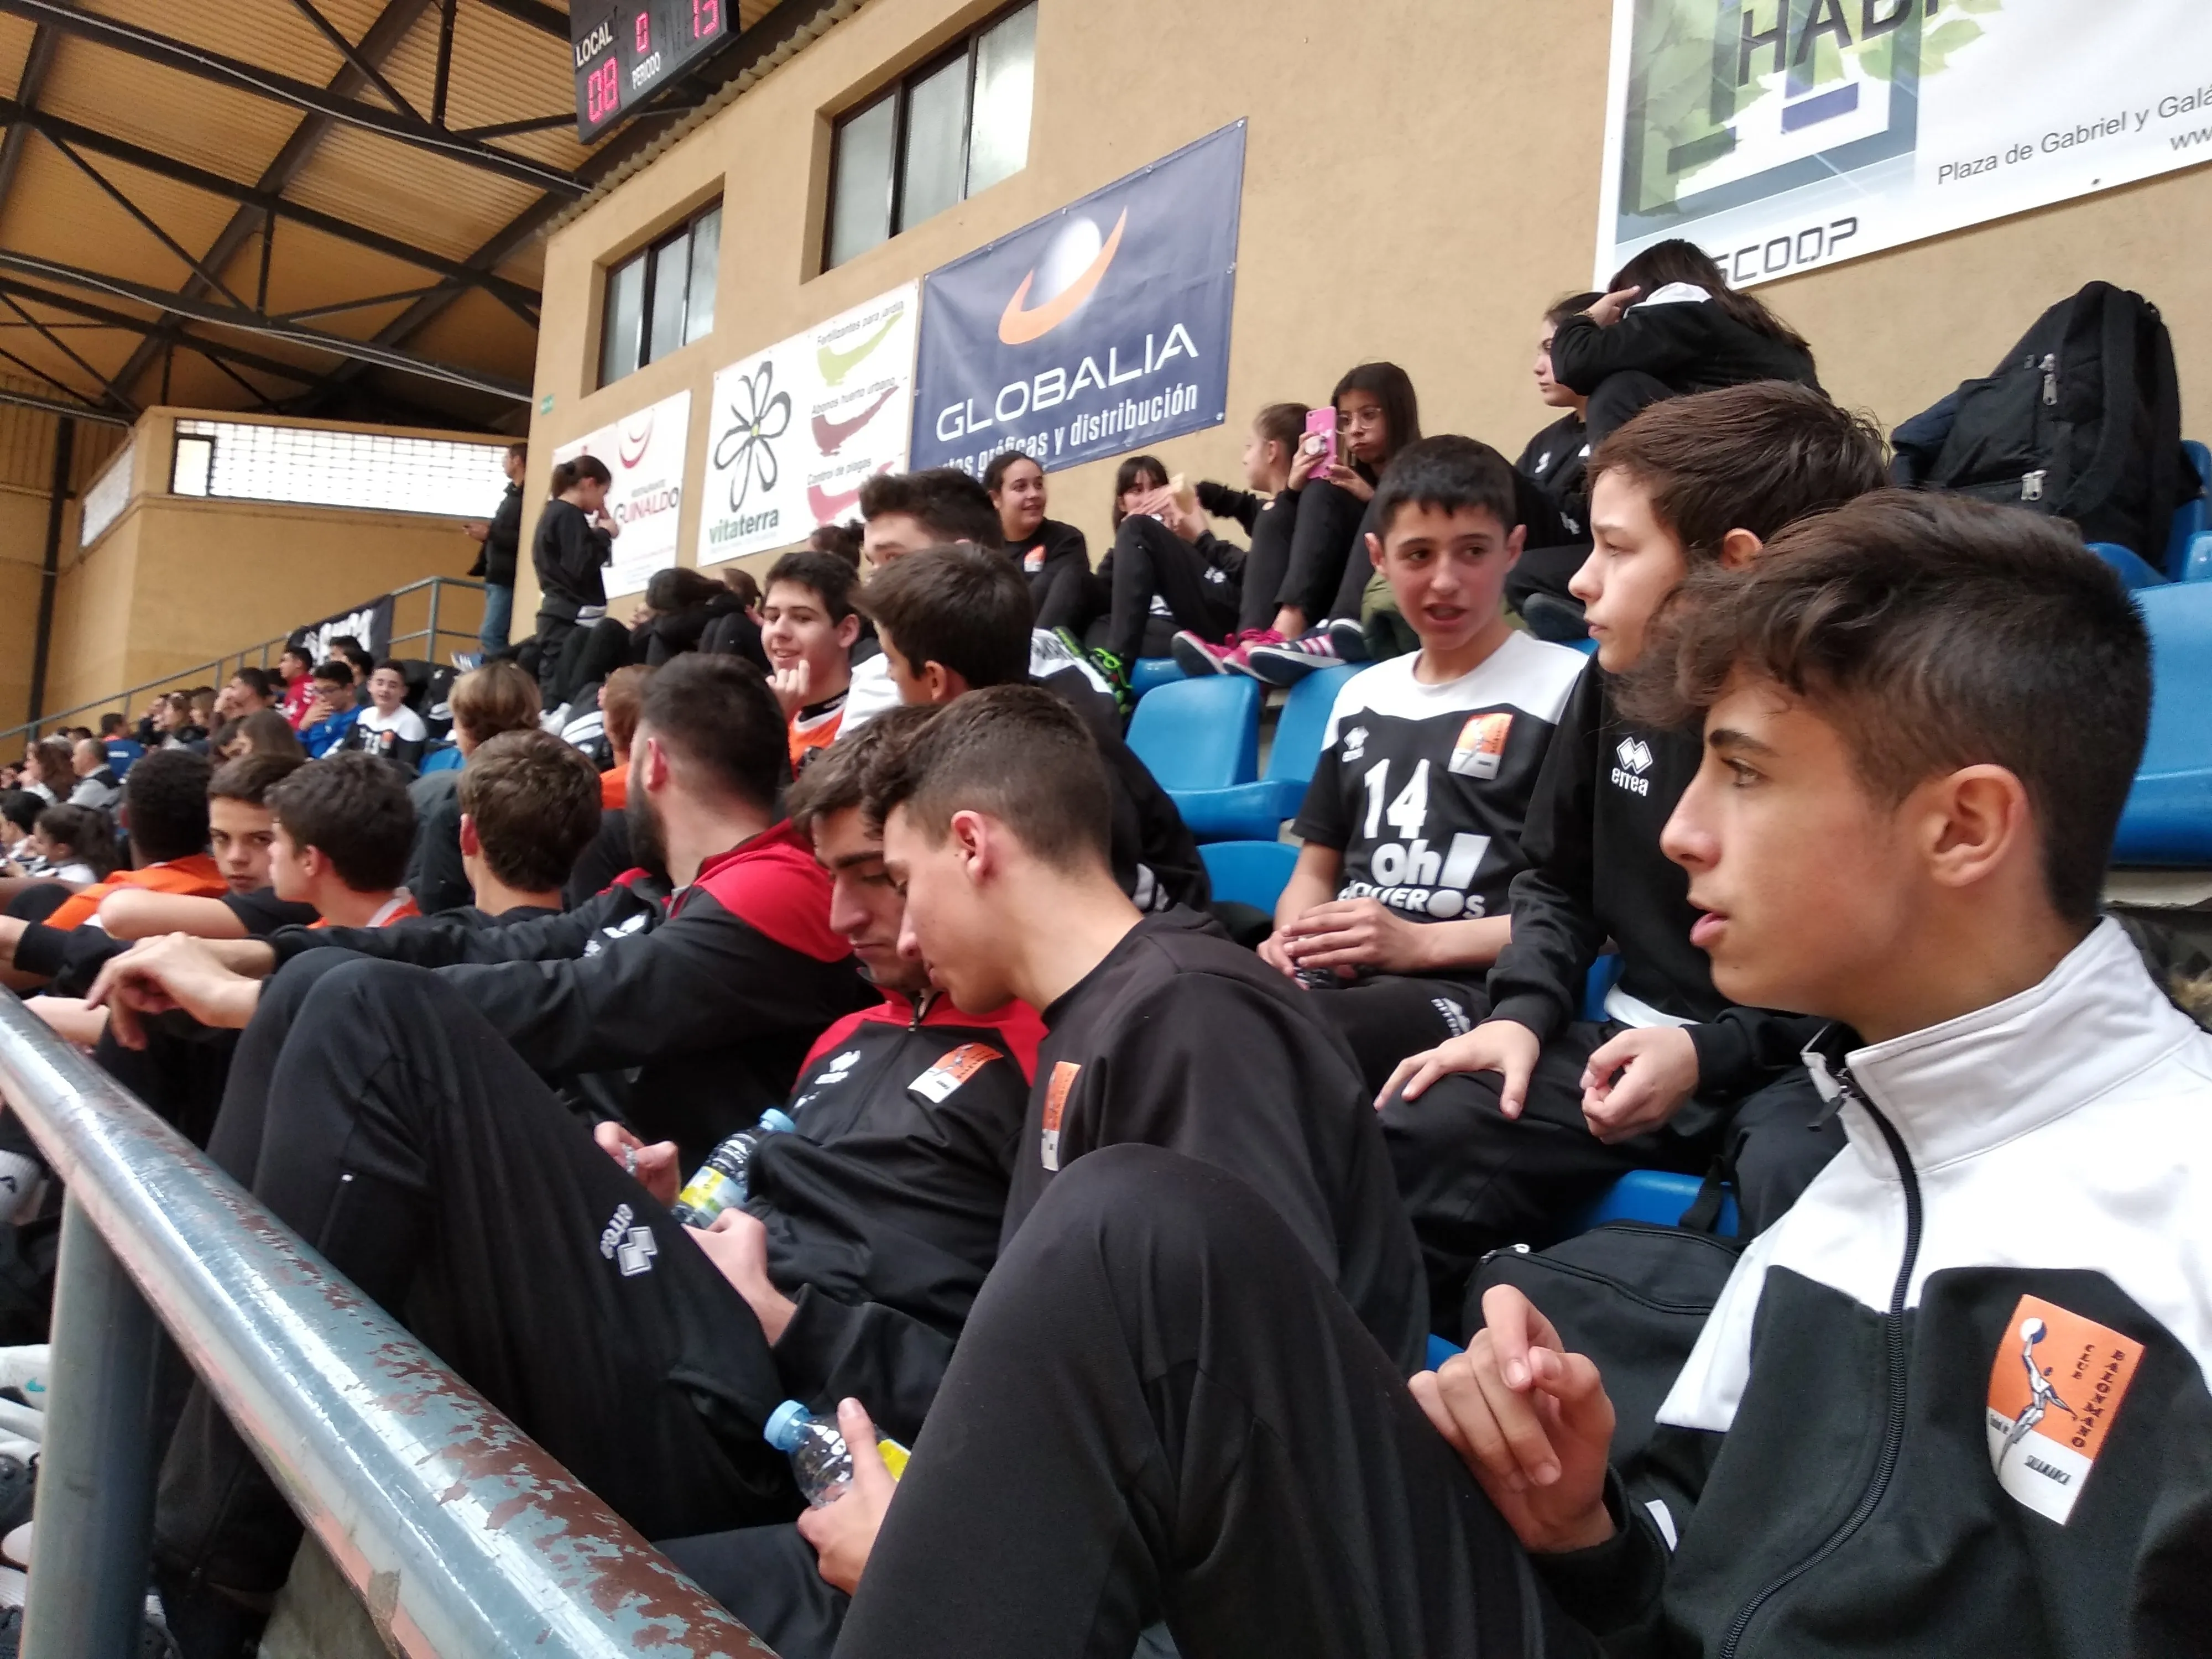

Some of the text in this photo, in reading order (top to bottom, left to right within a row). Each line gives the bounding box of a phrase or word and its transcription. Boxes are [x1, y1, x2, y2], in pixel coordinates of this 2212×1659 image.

[576, 22, 613, 67] LOCAL
[632, 51, 660, 90] PERIODO
[1738, 0, 1938, 87] HAB
[1938, 154, 1998, 184] Plaza
[2005, 144, 2033, 165] de
[2041, 112, 2126, 153] Gabriel
[2135, 109, 2150, 132] y
[936, 323, 1199, 441] GLOBALIA
[1054, 427, 1065, 456] y
[1070, 383, 1198, 446] distribución
[709, 508, 779, 544] vitaterra
[1363, 758, 1430, 839] 14
[1611, 767, 1649, 797] errea
